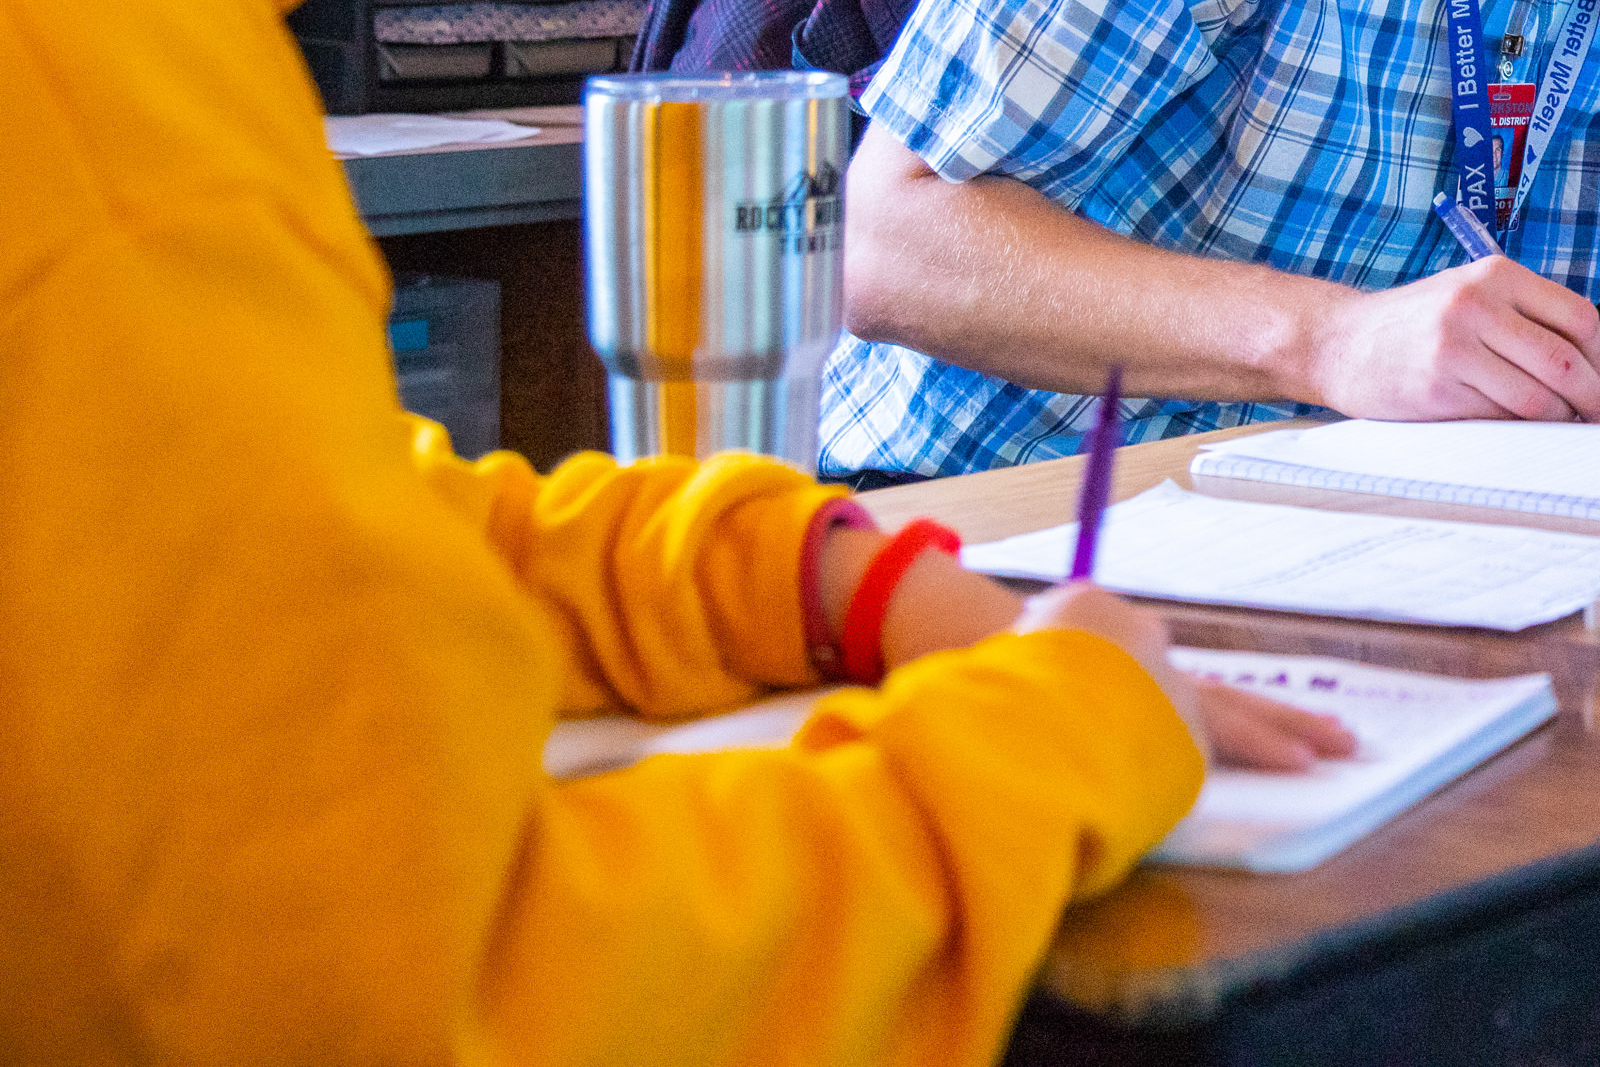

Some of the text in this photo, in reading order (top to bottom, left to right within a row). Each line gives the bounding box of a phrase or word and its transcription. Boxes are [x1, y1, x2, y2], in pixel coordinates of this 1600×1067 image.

[1456, 25, 1478, 96] Better
[1459, 102, 1479, 110] I
[1490, 102, 1534, 114] RKSTON
[1499, 116, 1530, 126] DISTRICT
[1464, 162, 1488, 211] PAX
